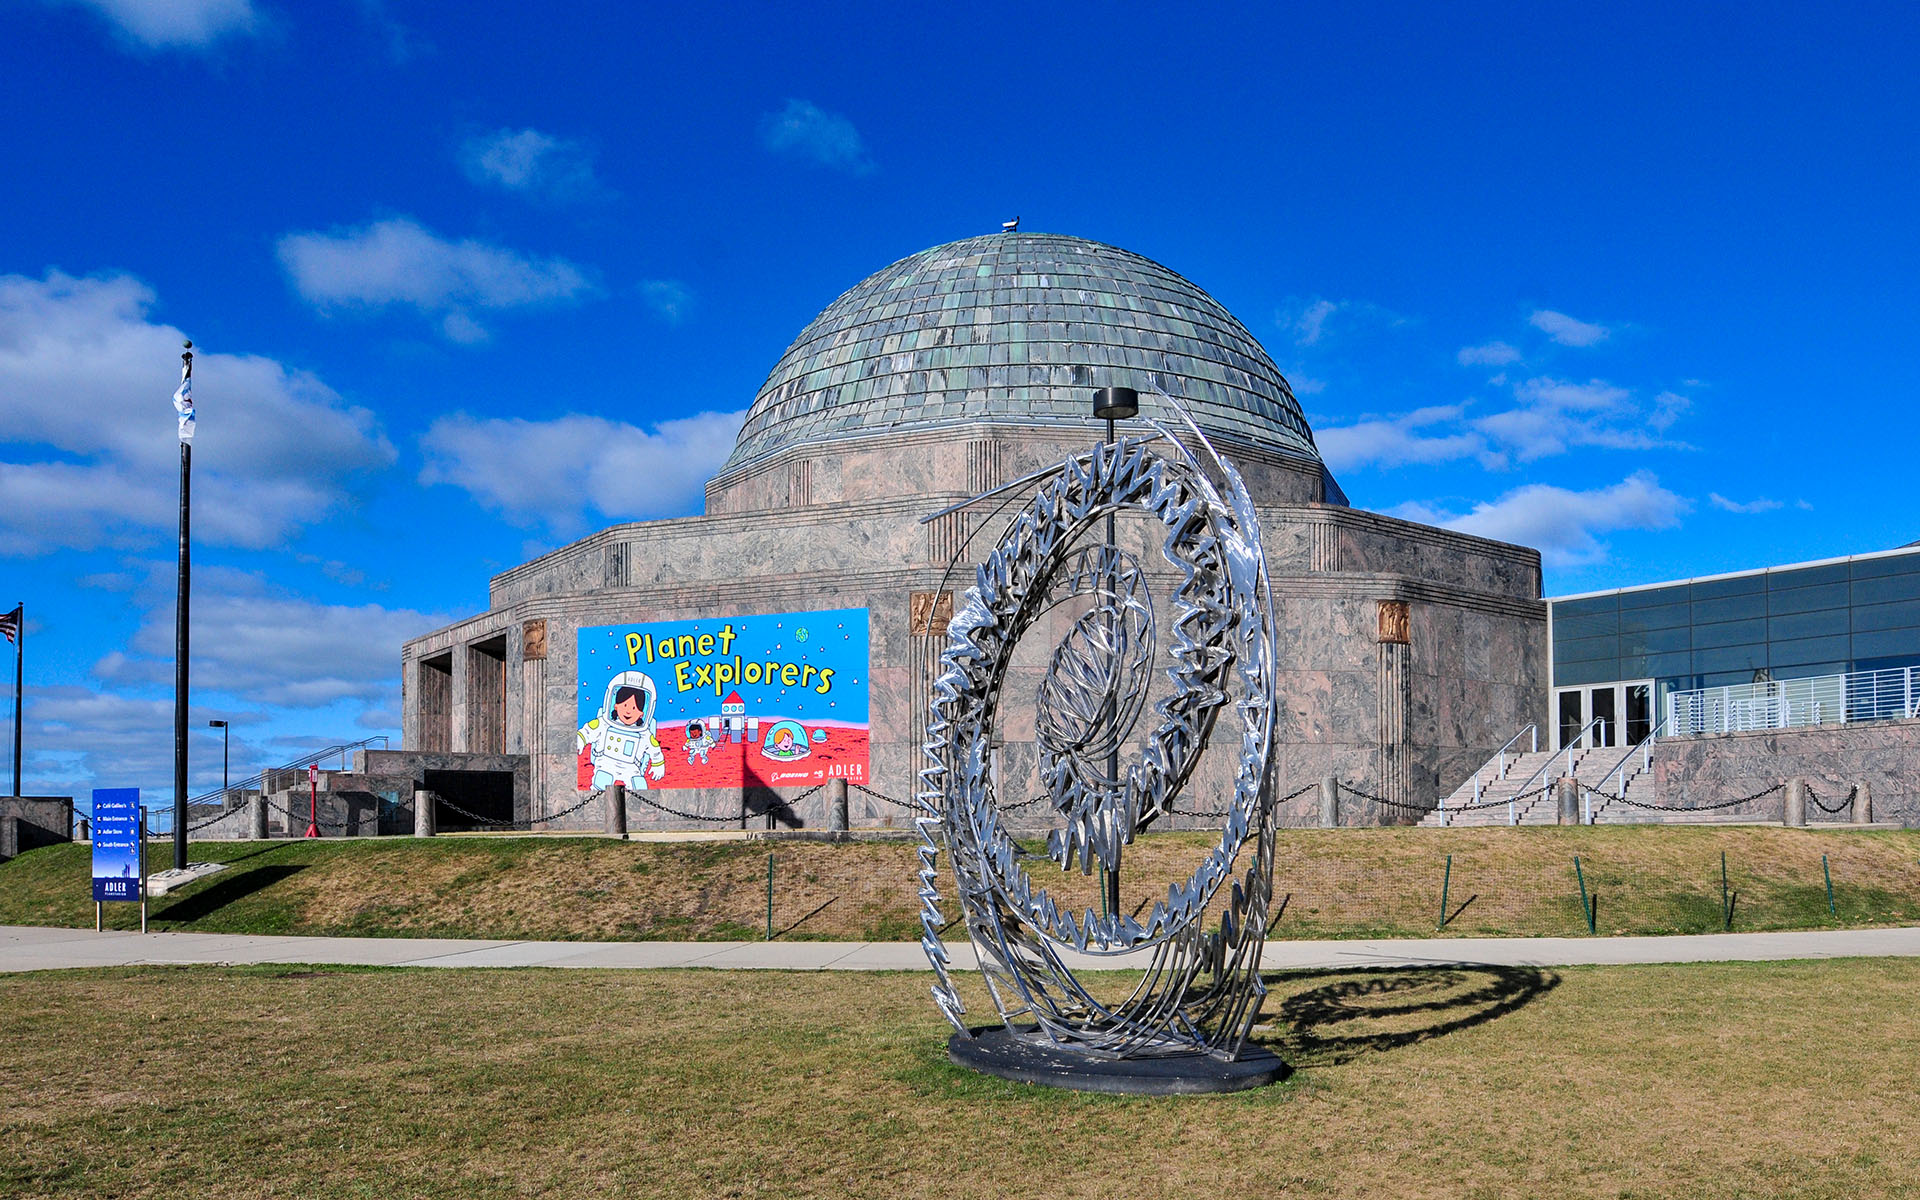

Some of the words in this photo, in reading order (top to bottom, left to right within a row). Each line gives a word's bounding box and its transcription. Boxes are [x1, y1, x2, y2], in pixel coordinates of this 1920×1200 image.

[624, 624, 738, 666] Planet
[674, 655, 836, 697] Explorers
[828, 764, 863, 776] ADLER
[104, 882, 127, 892] ADLER
